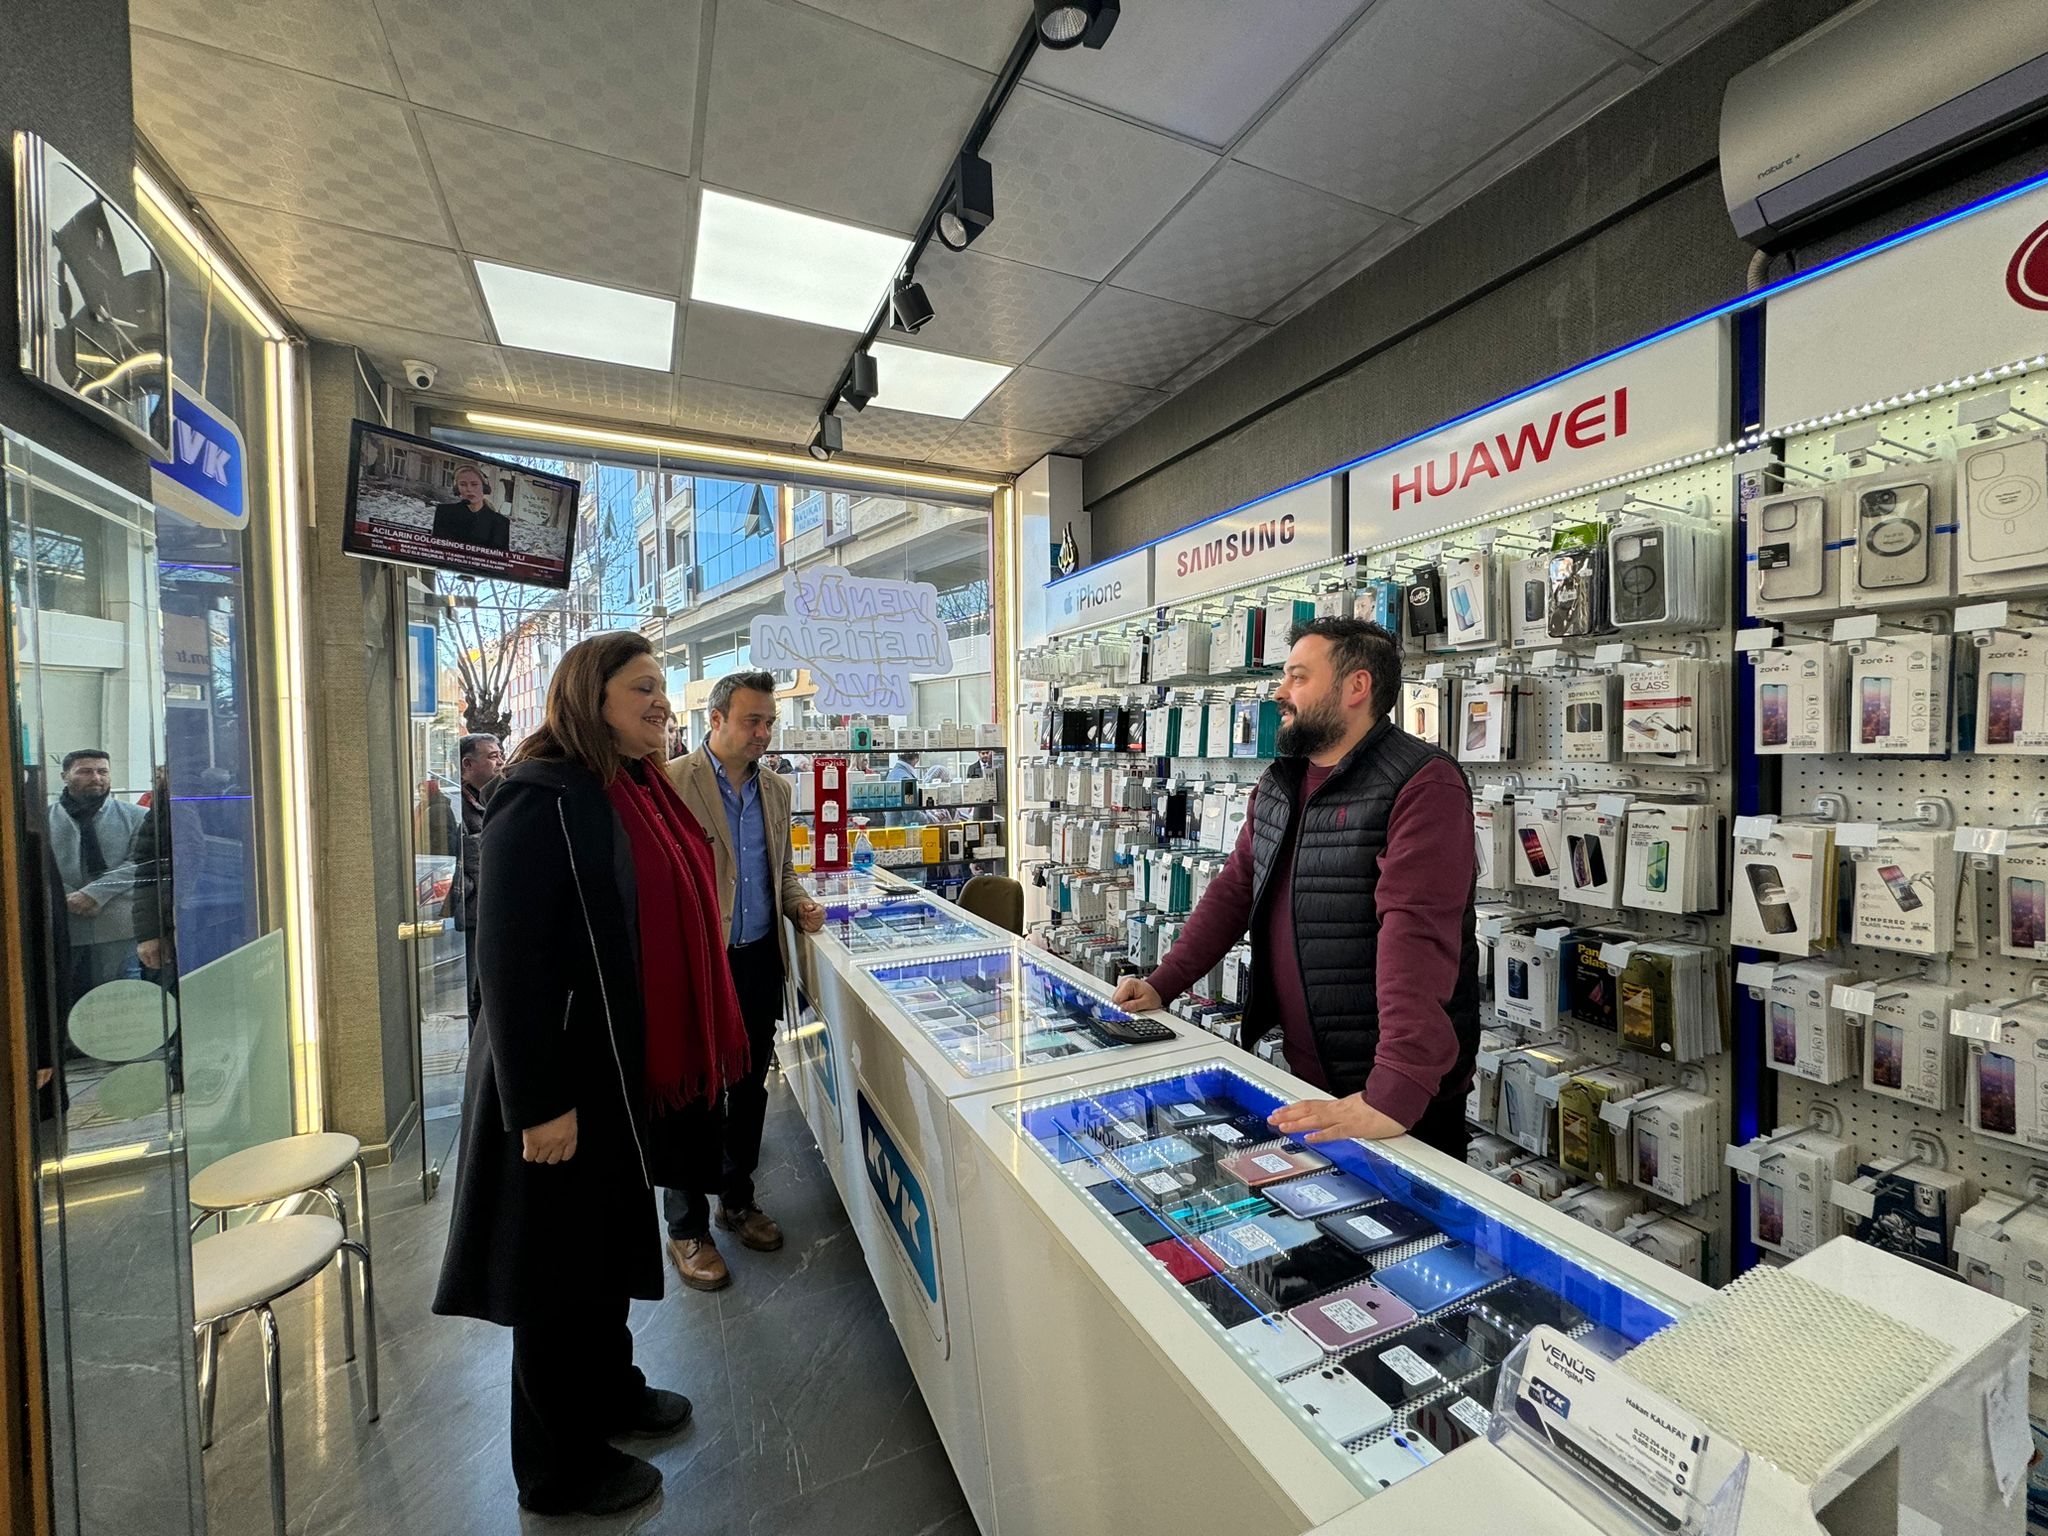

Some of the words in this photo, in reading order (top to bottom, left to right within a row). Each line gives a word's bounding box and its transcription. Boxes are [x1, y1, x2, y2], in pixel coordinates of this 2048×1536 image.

[1757, 157, 1793, 180] nature
[1392, 386, 1627, 512] HUAWEI
[372, 526, 412, 540] ACILARIN
[413, 534, 464, 550] GÖLGESİNDE
[465, 544, 504, 558] DEPREMİN
[1176, 513, 1296, 578] SAMSUNG
[1075, 578, 1122, 612] iPhone
[1987, 650, 2016, 659] zore
[1629, 670, 1669, 678] PREMIUM
[1630, 681, 1670, 692] GLASS
[2006, 857, 2034, 865] zore
[1860, 916, 1905, 925] TEMPERED
[867, 1125, 921, 1253] KVK
[1919, 1187, 1934, 1197] 9H
[1541, 1338, 1596, 1382] VENÜS
[1534, 1384, 1566, 1408] KVK
[1625, 1397, 1649, 1417] Hakan
[1650, 1412, 1687, 1442] KALAFAT
